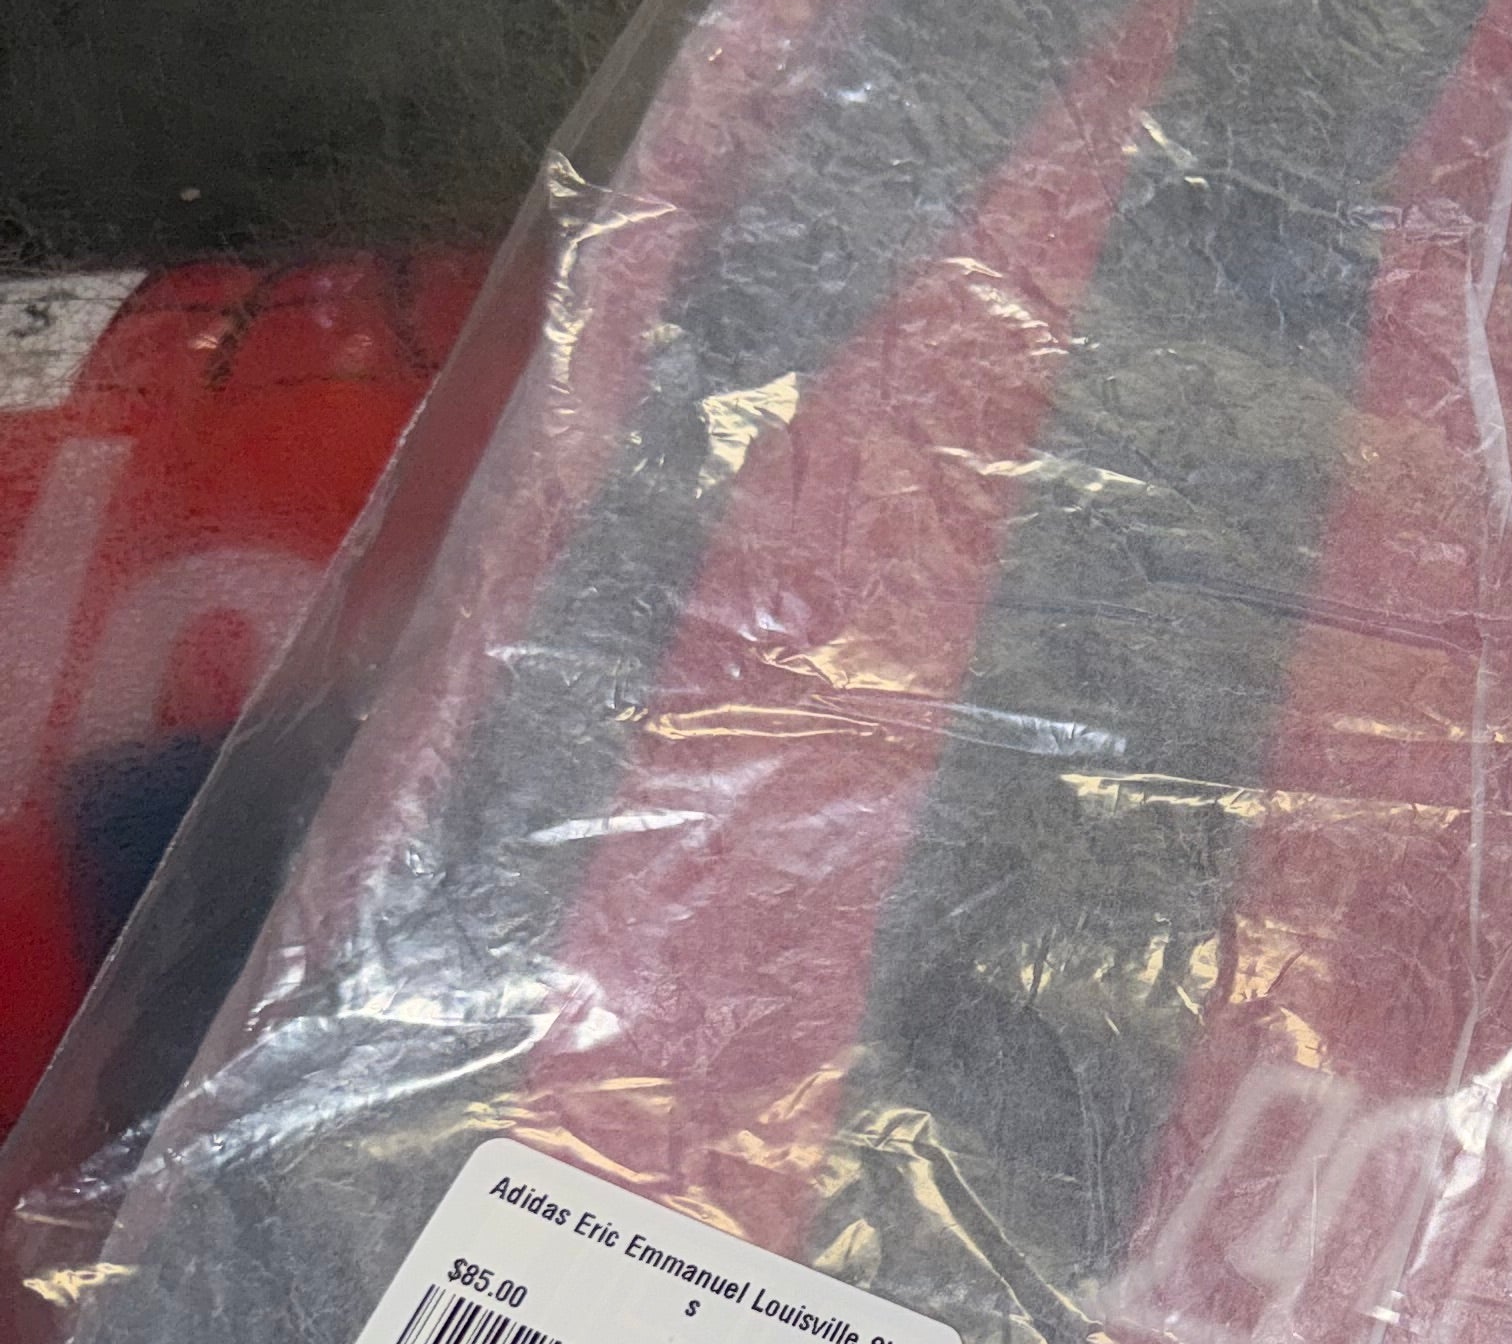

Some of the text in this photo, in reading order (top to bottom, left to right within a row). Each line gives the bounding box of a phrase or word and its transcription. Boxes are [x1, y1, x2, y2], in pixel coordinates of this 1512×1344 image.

[447, 1257, 529, 1309] $85.00
[489, 1175, 572, 1226] Adidas
[574, 1211, 620, 1249] Eric
[624, 1234, 749, 1305] Emmanuel
